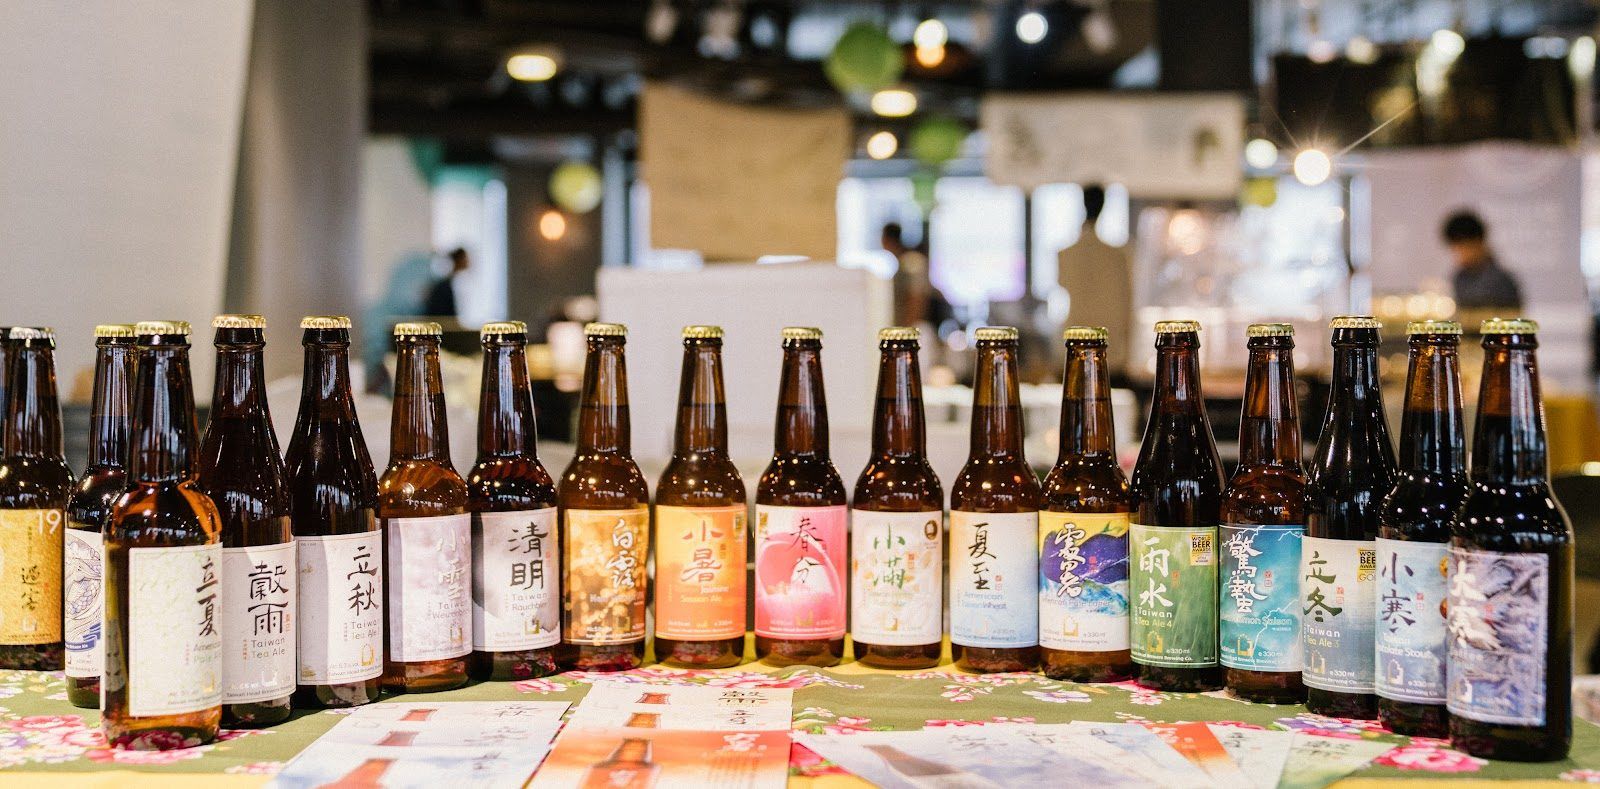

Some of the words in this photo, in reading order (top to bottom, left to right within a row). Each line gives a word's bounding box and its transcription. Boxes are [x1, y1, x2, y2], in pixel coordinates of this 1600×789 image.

[36, 510, 61, 535] 19
[507, 522, 548, 591] 清明
[605, 519, 636, 588] 白露
[681, 519, 724, 582] 小暑
[787, 516, 824, 584] 春分
[968, 522, 997, 590] 夏至
[347, 545, 380, 616] 立秋
[436, 527, 469, 600] 小雪
[1139, 537, 1173, 609] 雨水
[1228, 534, 1268, 613] 驚蟄
[1303, 551, 1343, 622] 立冬
[1360, 556, 1376, 564] BEE
[1381, 552, 1416, 633] 小寒
[196, 557, 218, 636] 立夏
[248, 561, 289, 636] 穀雨
[512, 593, 548, 601] Taiwan
[1138, 606, 1173, 618] Taiwan
[1138, 617, 1149, 626] Tea
[1152, 619, 1165, 628] Ale
[1306, 624, 1340, 637] Taiwan
[251, 637, 285, 649] Taiwan
[251, 650, 269, 659] Tea
[272, 647, 285, 656] Ale
[1319, 638, 1332, 648] Ale
